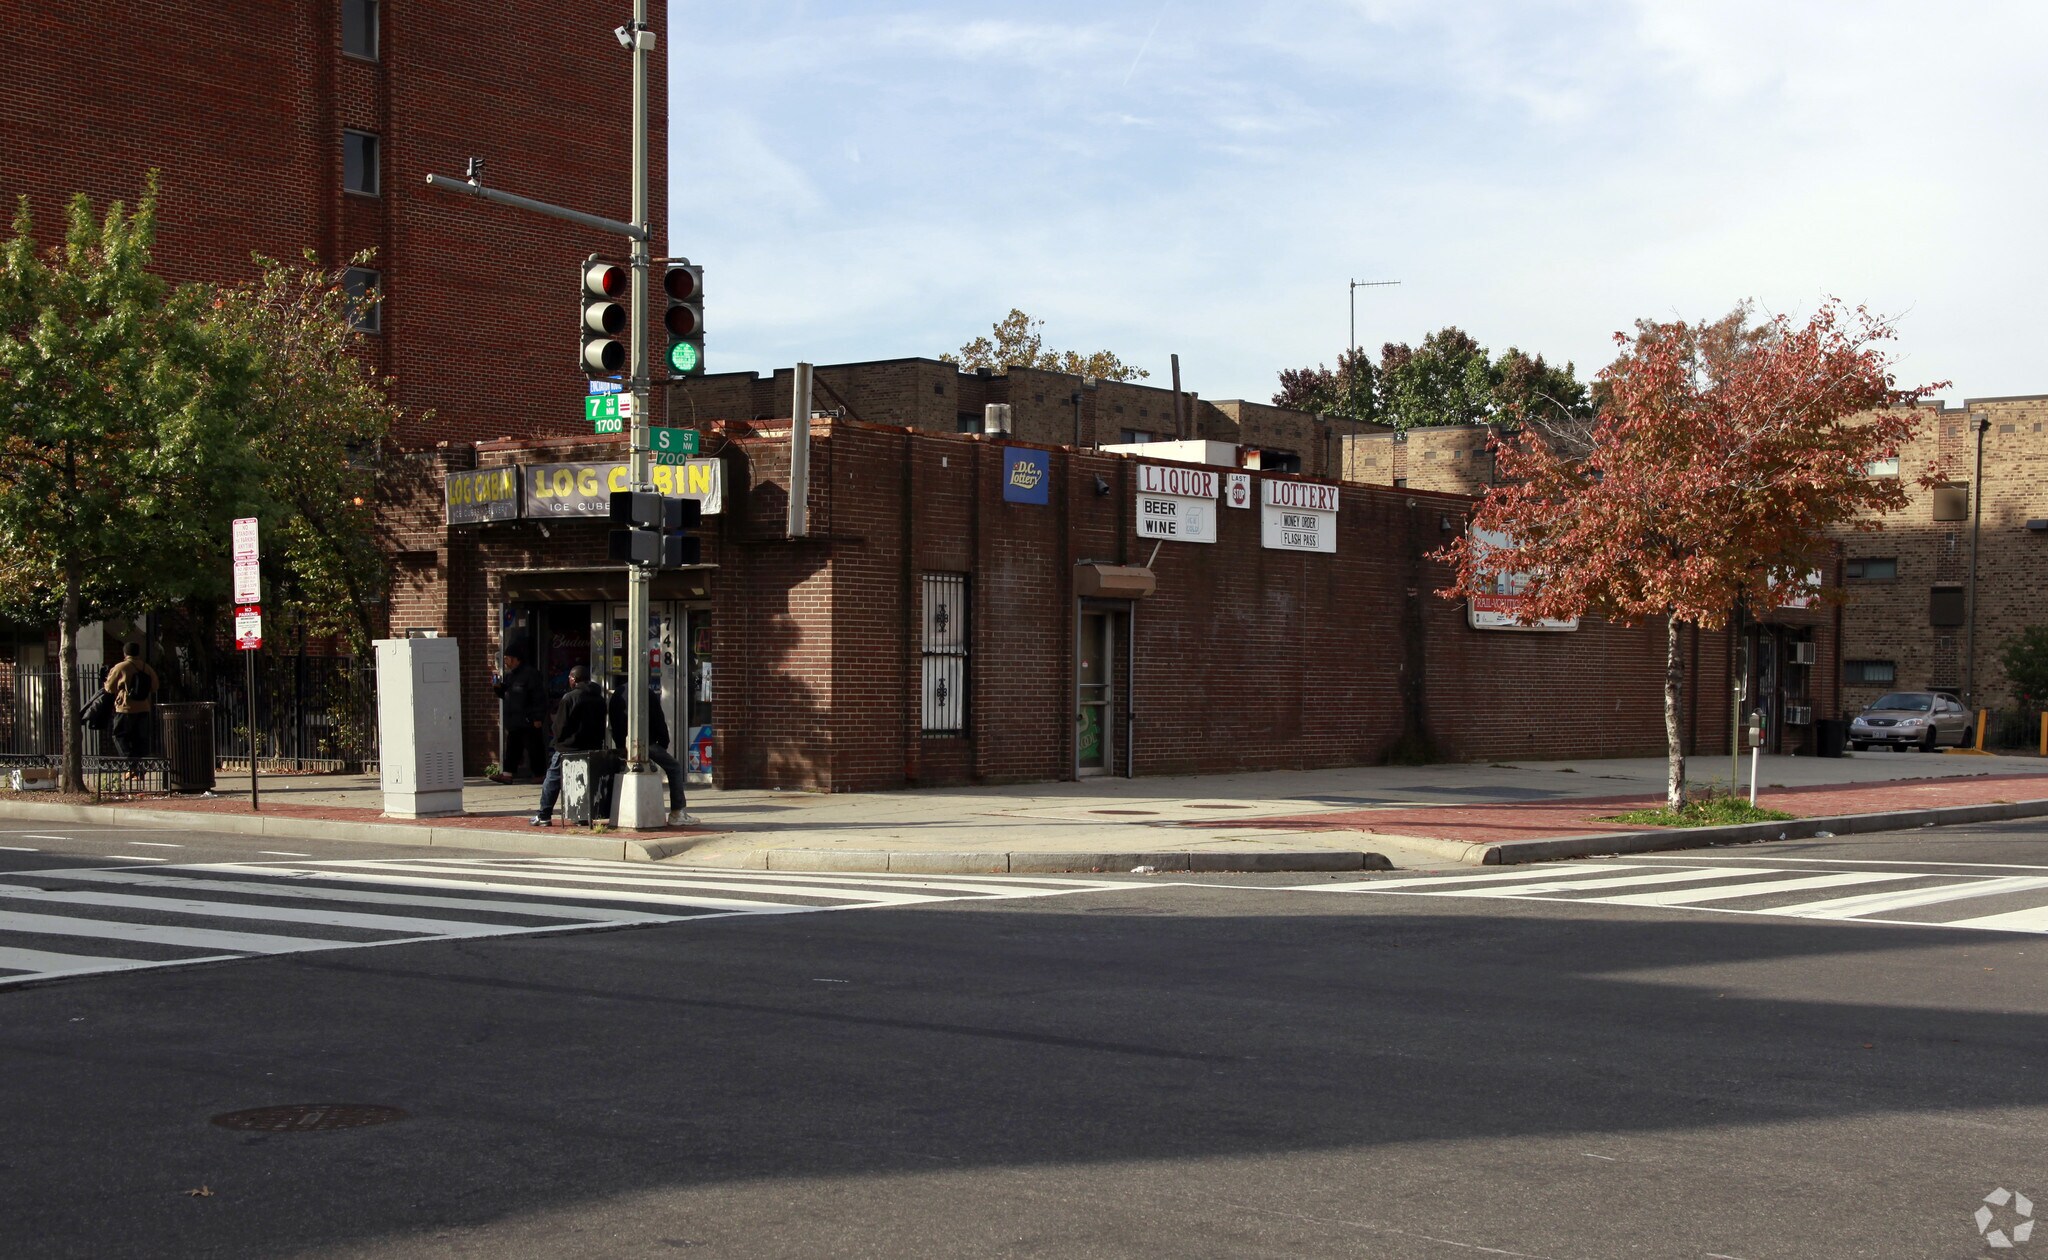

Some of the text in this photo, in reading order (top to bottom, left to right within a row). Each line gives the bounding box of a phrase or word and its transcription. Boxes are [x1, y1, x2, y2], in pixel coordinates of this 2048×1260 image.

[590, 398, 614, 416] 7 ST
[596, 419, 622, 432] 1700
[659, 431, 692, 448] S ST
[683, 442, 692, 450] NW
[658, 452, 685, 465] 700
[1019, 461, 1036, 474] D.C.
[535, 465, 710, 498] LOG CBIN
[1009, 470, 1042, 489] Lottery
[1145, 467, 1212, 496] LIQUOR
[449, 471, 513, 506] LOG CABIN
[1233, 488, 1245, 499] STOP
[1273, 480, 1335, 509] LOTTERY
[550, 503, 570, 511] ICE
[1145, 501, 1176, 515] BEER
[1146, 520, 1176, 534] WINE
[1284, 515, 1316, 528] MONEY ORDER
[1284, 533, 1316, 546] FLASH PASS
[664, 602, 672, 666] 1748
